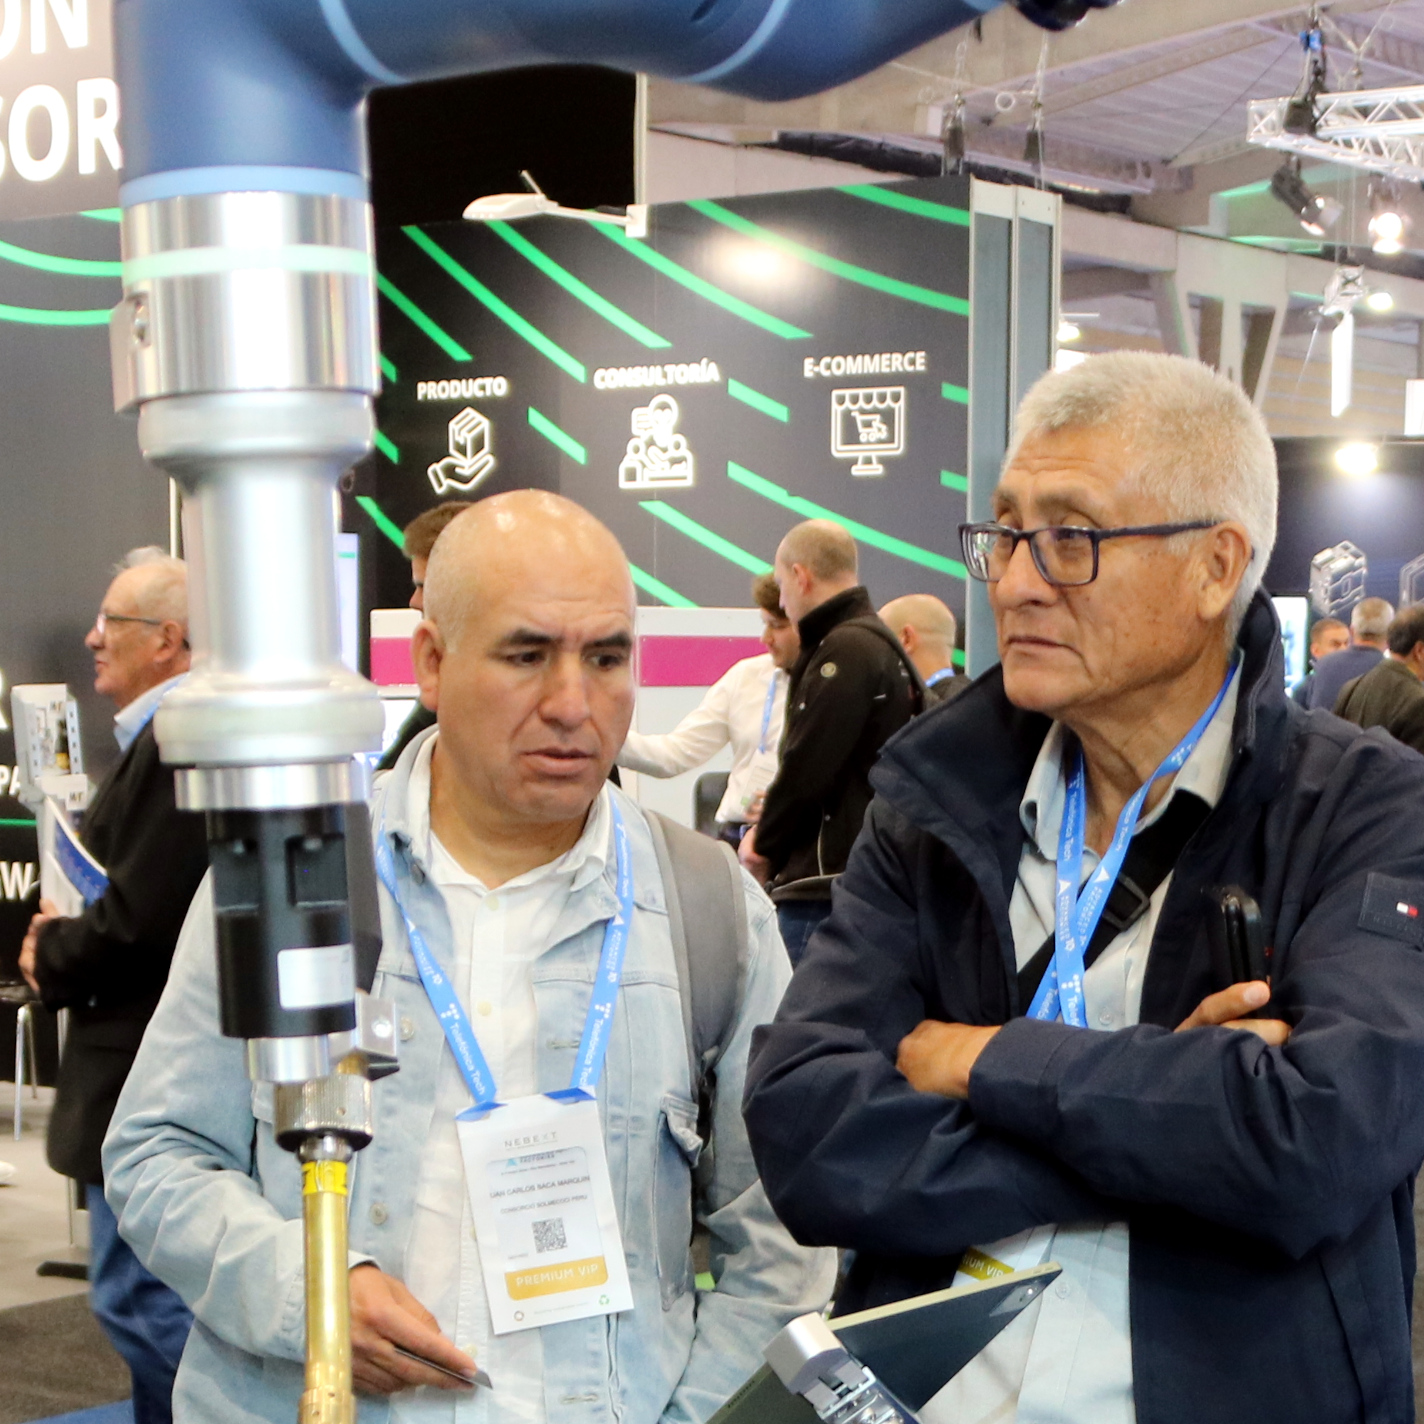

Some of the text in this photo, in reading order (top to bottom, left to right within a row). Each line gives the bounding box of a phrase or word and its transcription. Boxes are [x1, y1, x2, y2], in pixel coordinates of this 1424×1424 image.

[593, 357, 721, 391] CONSULTORÍA
[803, 351, 928, 378] E-COMMERCE
[417, 376, 508, 402] PRODUCTO
[504, 1132, 558, 1148] NEBEXT
[515, 1263, 600, 1288] PREMIUM VIP
